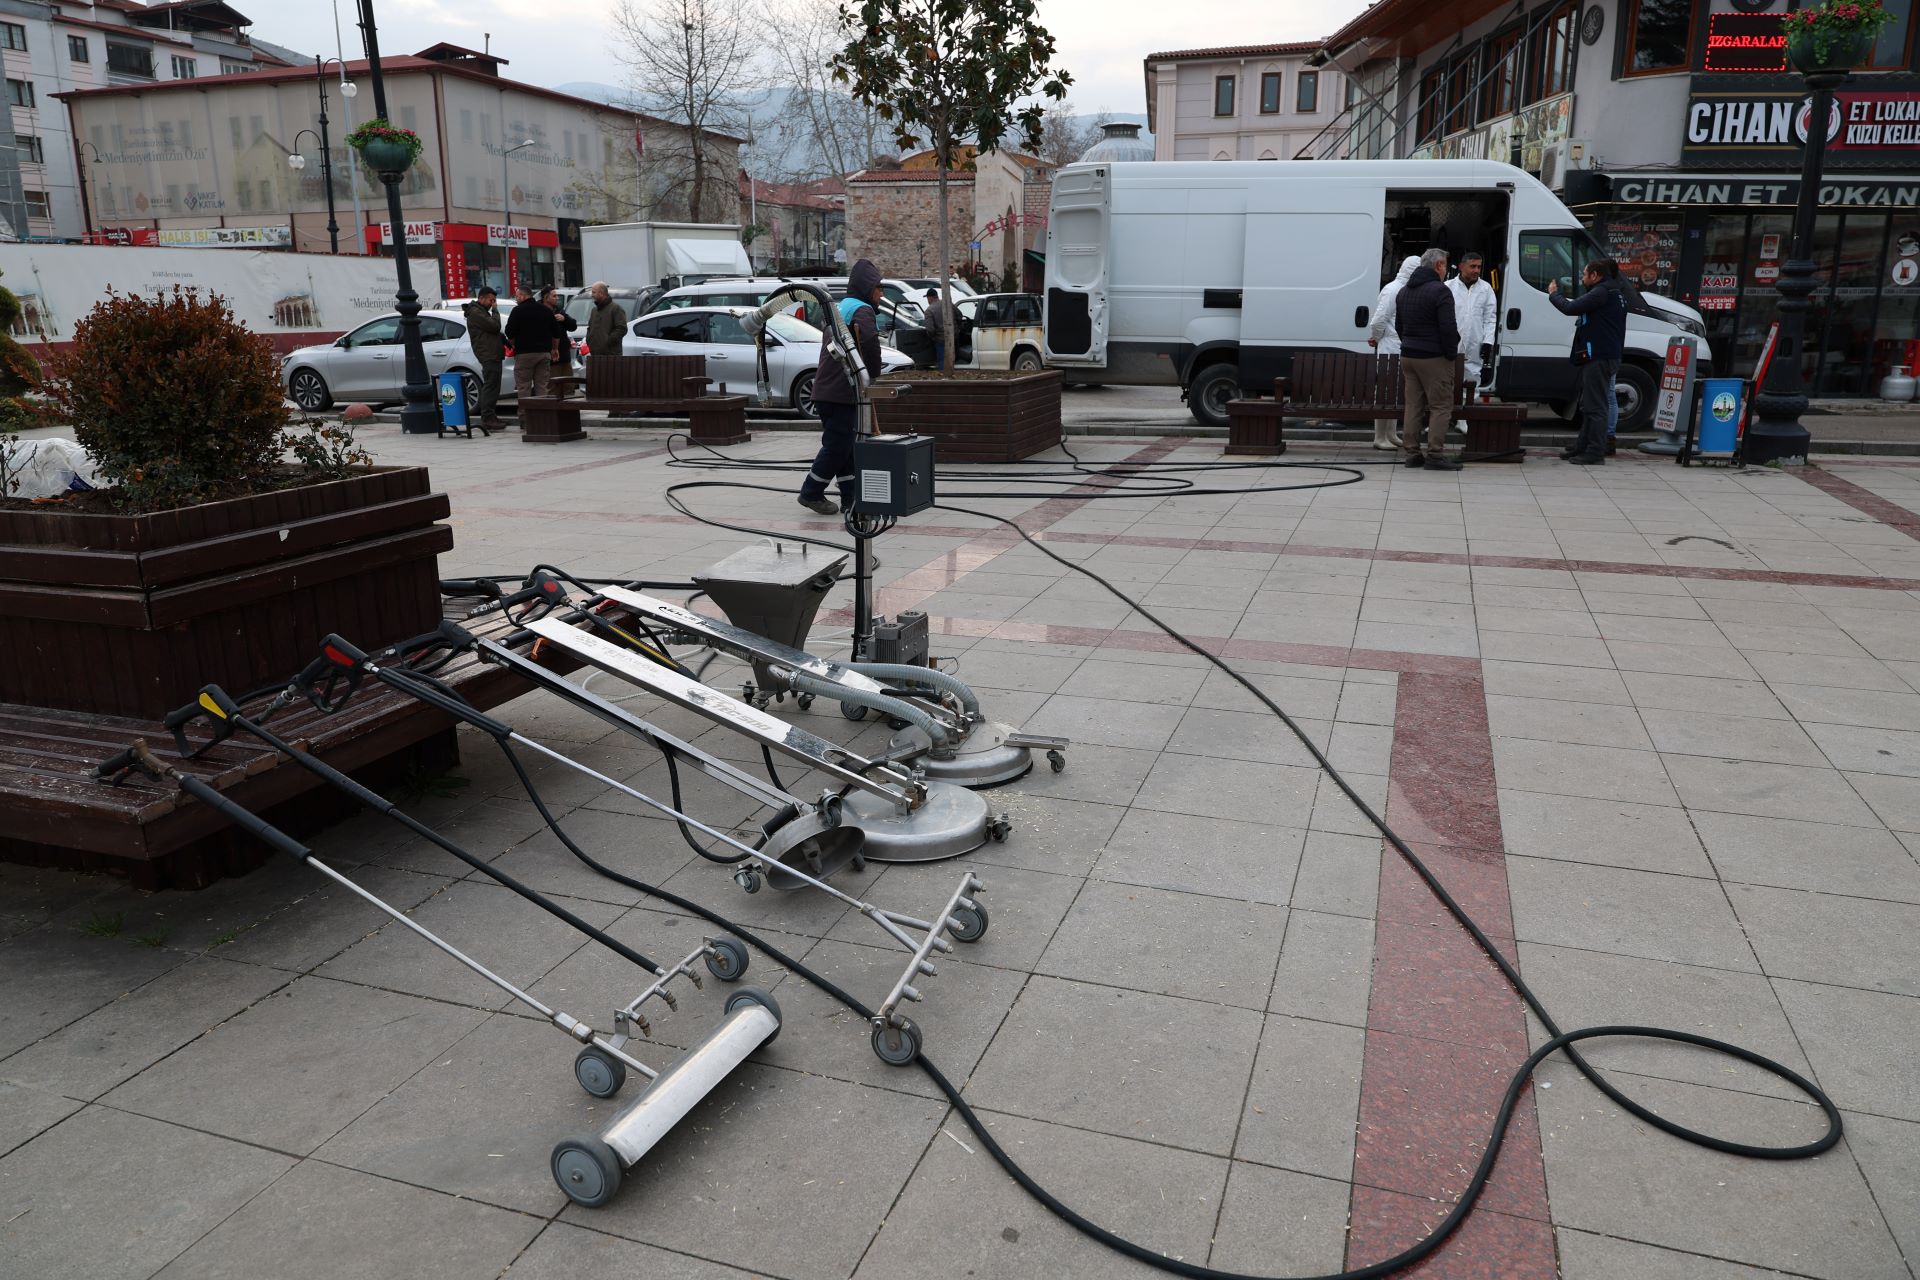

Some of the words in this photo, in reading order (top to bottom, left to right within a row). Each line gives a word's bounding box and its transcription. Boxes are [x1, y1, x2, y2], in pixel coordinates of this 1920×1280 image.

[1849, 101, 1872, 121] ET
[1688, 102, 1794, 143] CİHAN
[1846, 124, 1882, 145] KUZU
[1620, 179, 1731, 204] CİHAN
[1741, 184, 1788, 204] ET
[1802, 186, 1919, 206] OKAN
[383, 224, 433, 237] EANE
[1656, 260, 1673, 269] 150
[1656, 279, 1669, 288] 80
